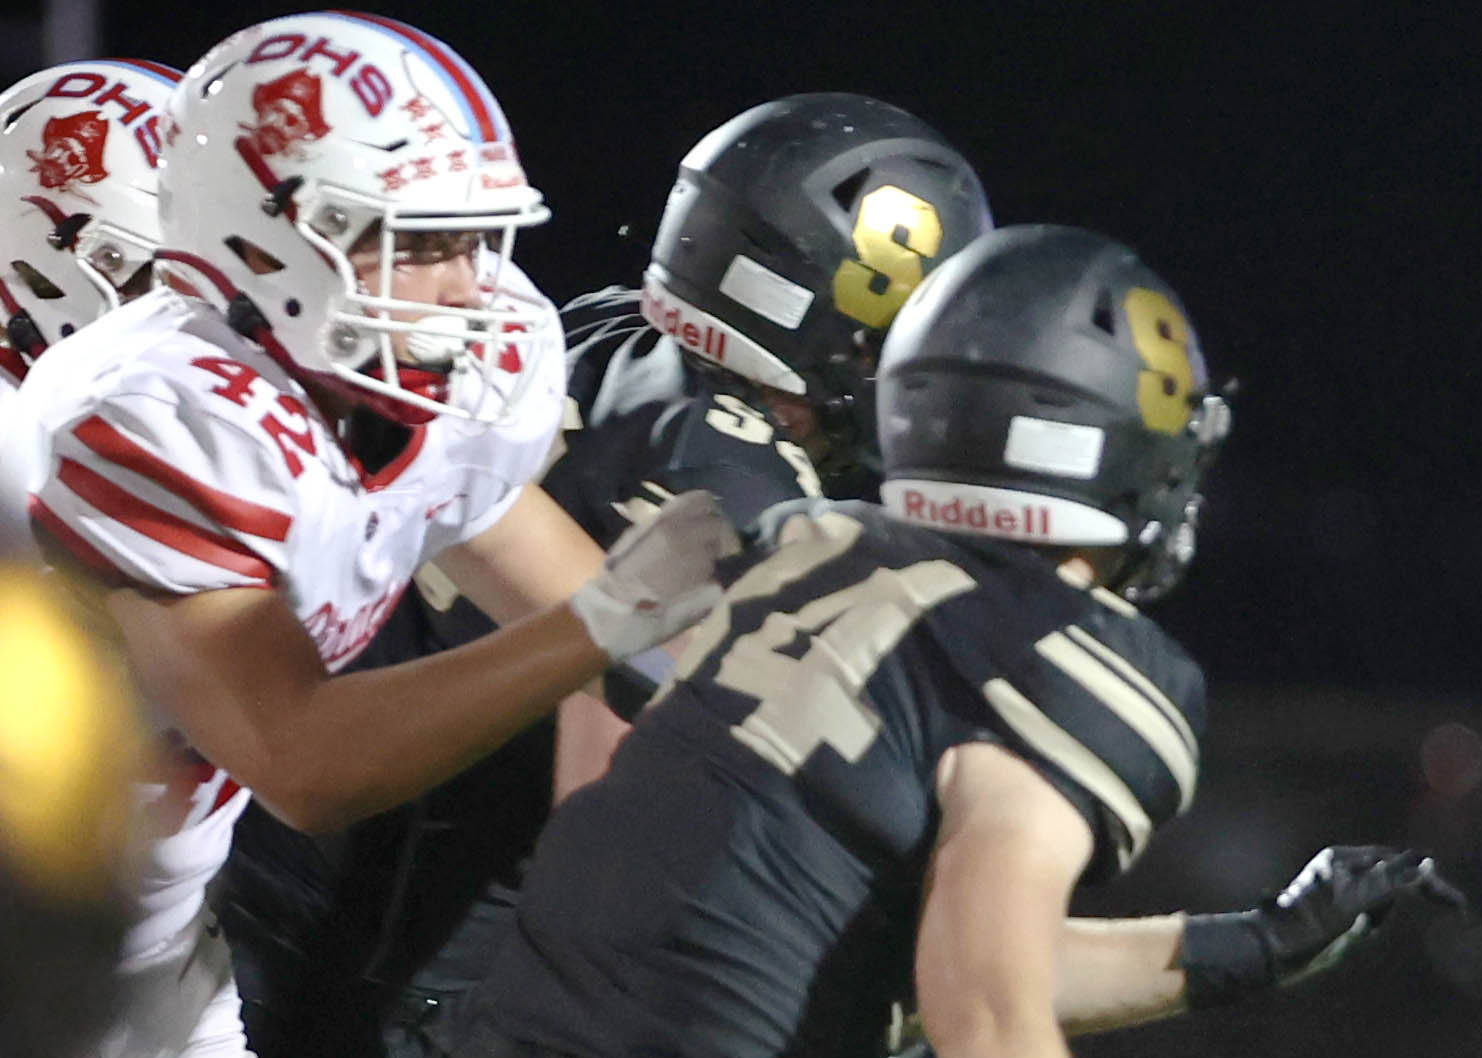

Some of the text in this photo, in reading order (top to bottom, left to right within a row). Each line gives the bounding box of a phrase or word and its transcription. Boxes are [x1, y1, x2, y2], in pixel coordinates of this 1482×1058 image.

[833, 184, 945, 328] S
[190, 356, 319, 480] 42
[903, 489, 1052, 537] Riddell
